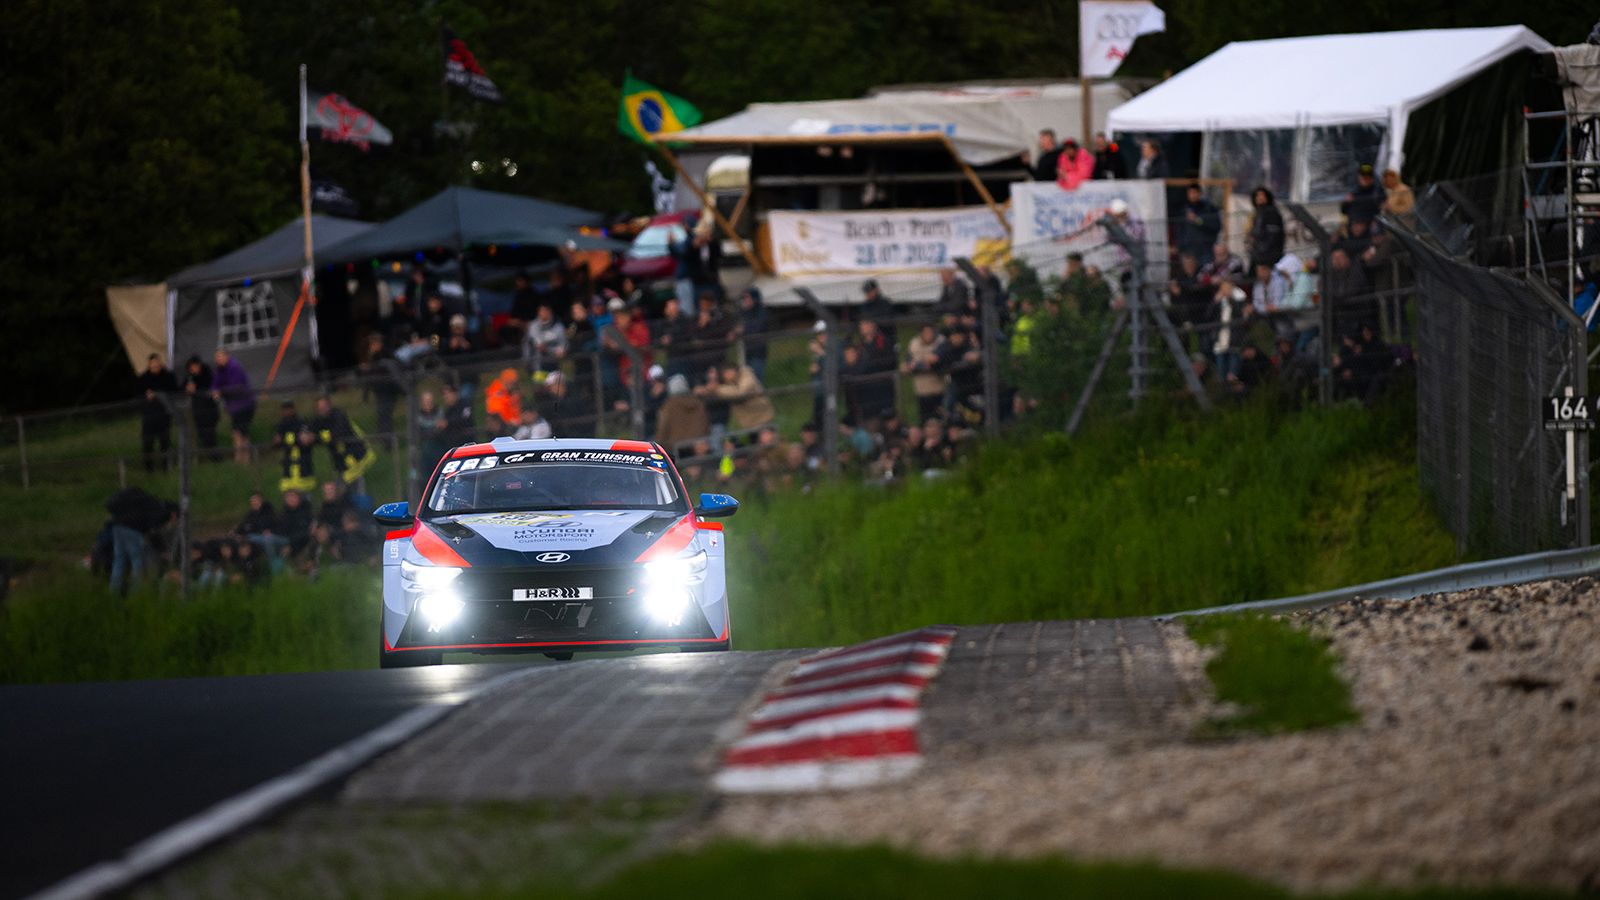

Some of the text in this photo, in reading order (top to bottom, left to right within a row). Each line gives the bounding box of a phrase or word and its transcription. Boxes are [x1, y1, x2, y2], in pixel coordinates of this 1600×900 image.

[1551, 397, 1588, 420] 164
[584, 452, 646, 462] TURISMO
[526, 588, 559, 598] H&R
